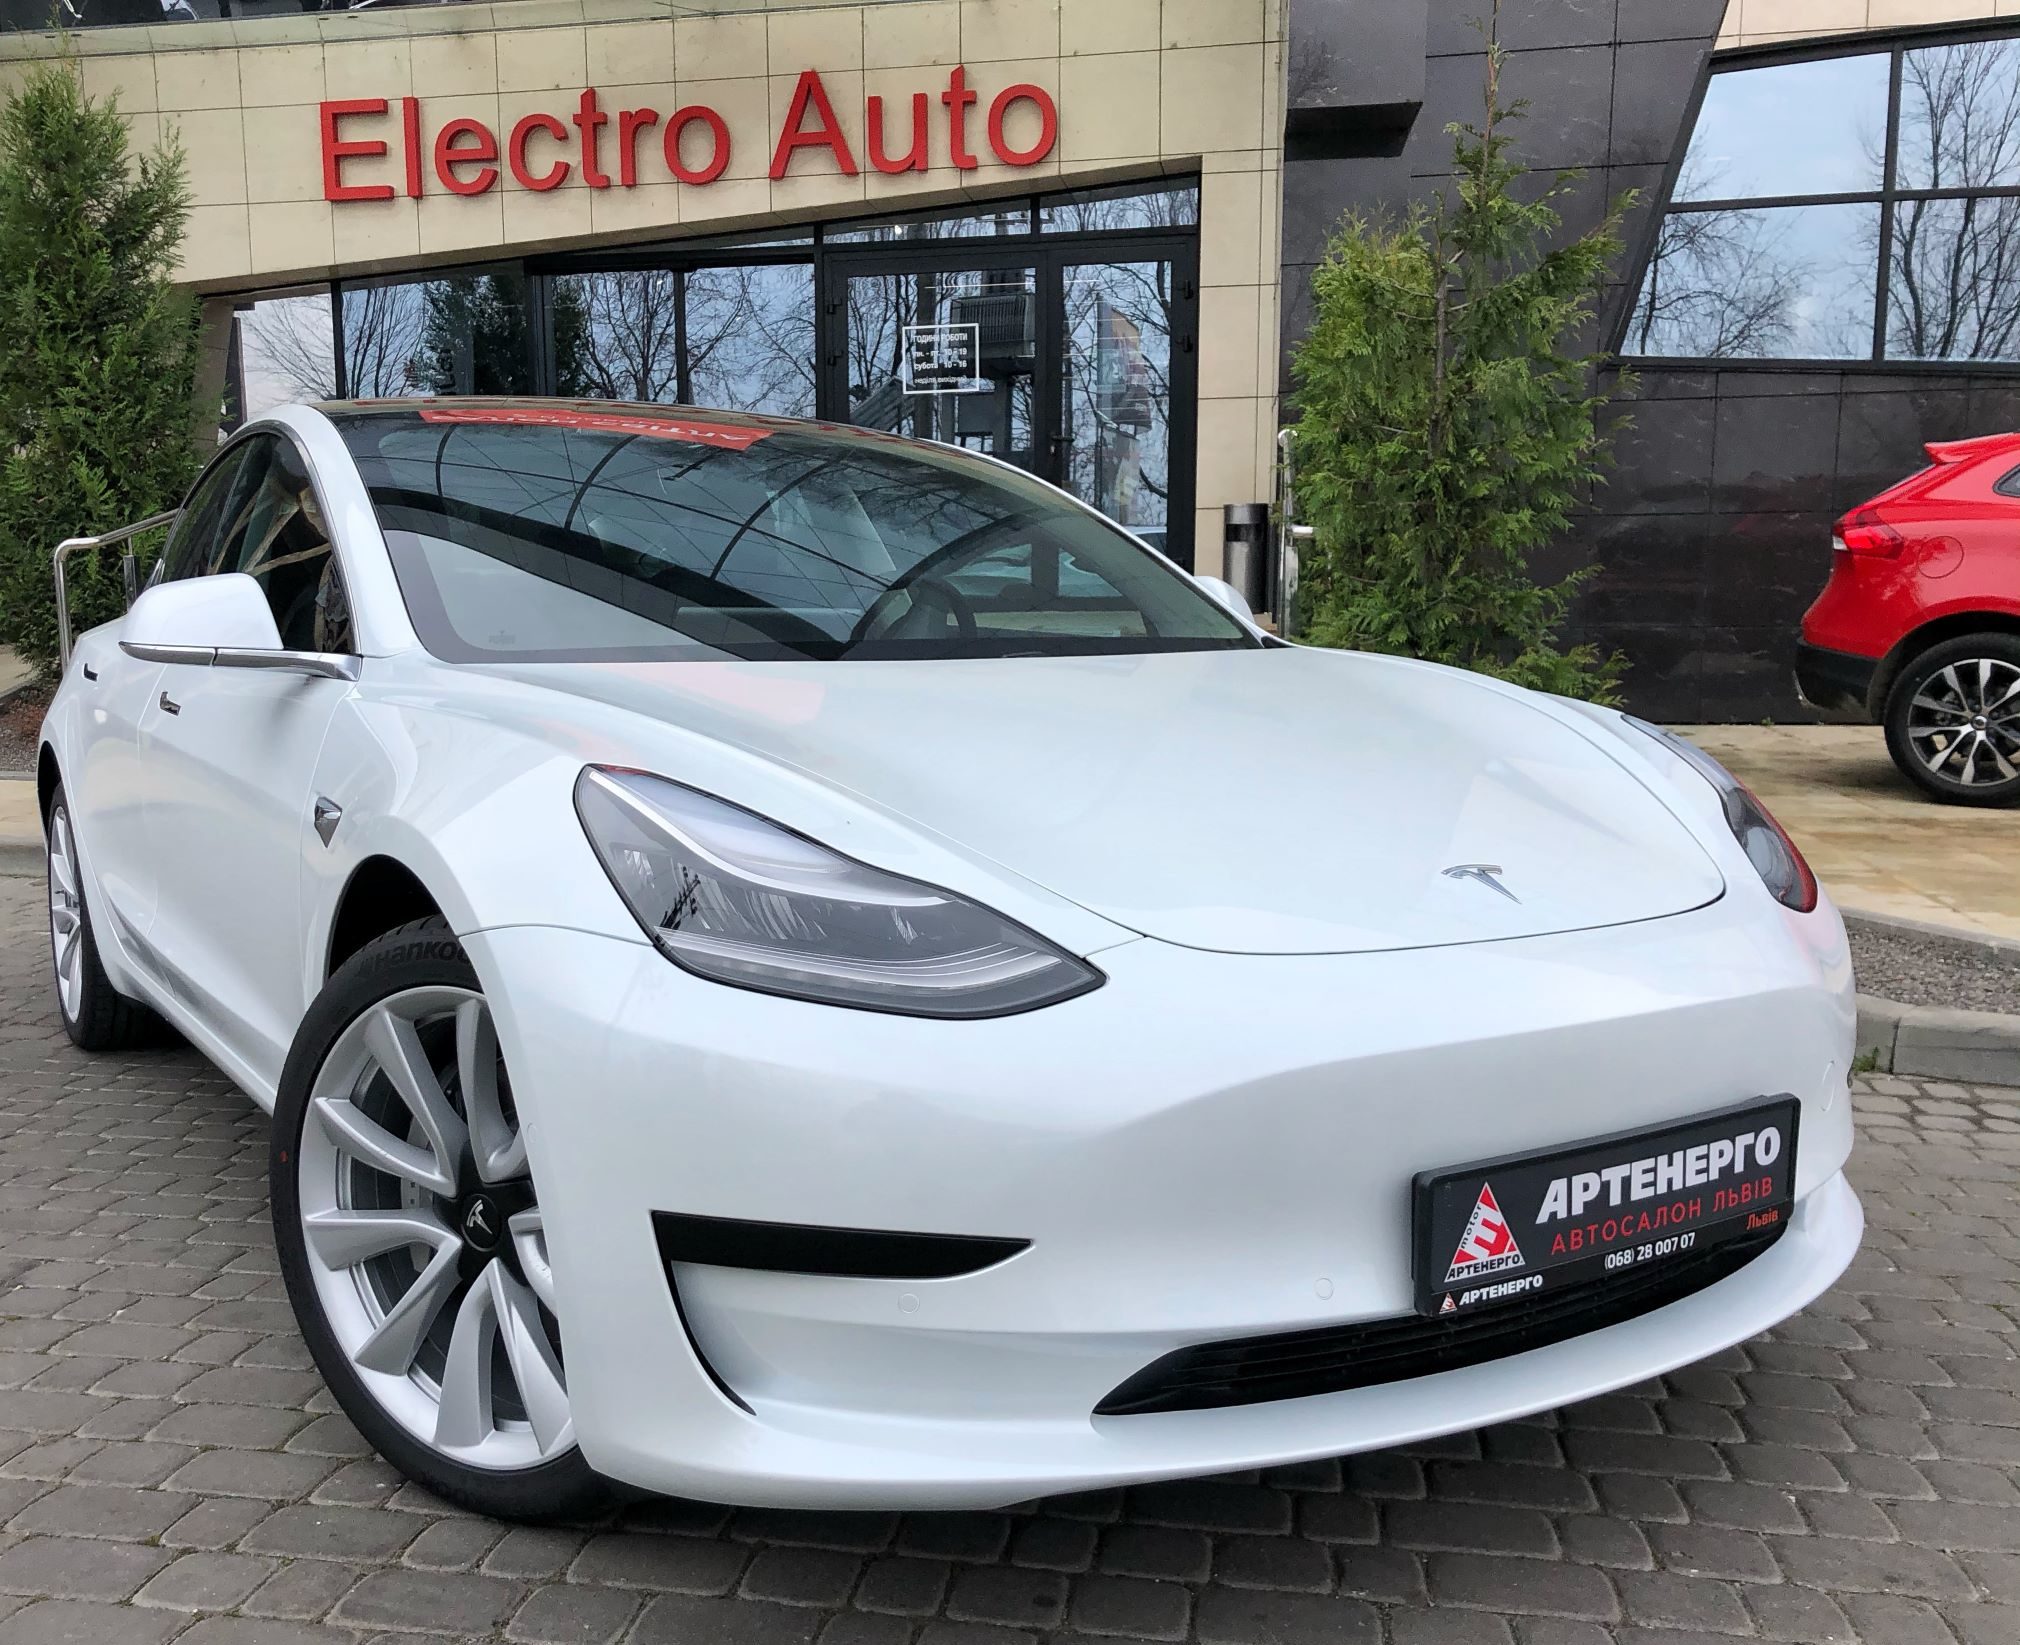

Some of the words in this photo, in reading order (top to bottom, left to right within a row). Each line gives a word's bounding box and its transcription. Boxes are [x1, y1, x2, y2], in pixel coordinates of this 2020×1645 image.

[320, 86, 731, 201] Electro
[769, 64, 1058, 180] Auto
[914, 362, 938, 371] субота
[944, 361, 952, 369] 10
[1535, 1126, 1781, 1224] АРТЕНЕРГО
[1461, 1204, 1482, 1249] motor
[1551, 1197, 1701, 1255] АВТОСАЛОН
[1712, 1176, 1772, 1213] ЛЬВІВ
[1746, 1209, 1779, 1231] Львів
[1447, 1254, 1521, 1280] АРТЕНЕРГО
[1604, 1247, 1635, 1270] (068)
[1637, 1243, 1653, 1262] 28
[1655, 1237, 1678, 1256] 007
[1680, 1232, 1696, 1250] 07
[1459, 1274, 1544, 1306] АРТЕНЕРГО
